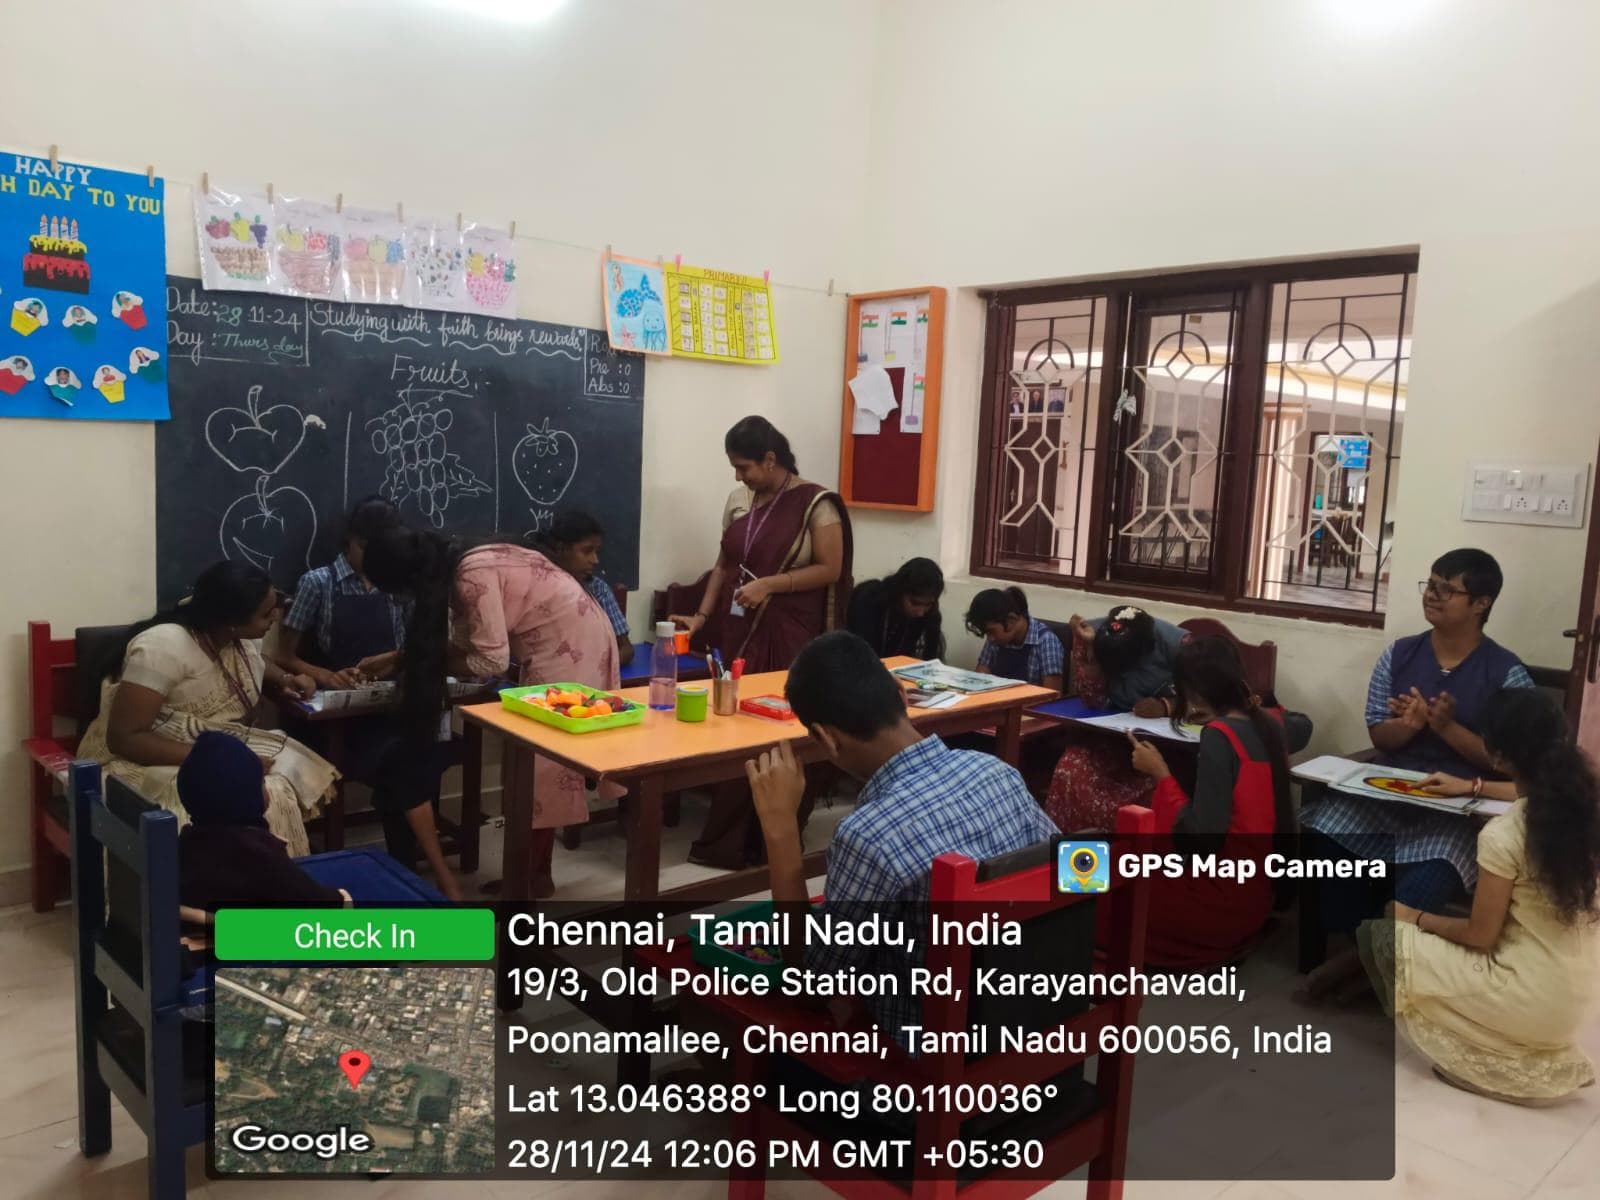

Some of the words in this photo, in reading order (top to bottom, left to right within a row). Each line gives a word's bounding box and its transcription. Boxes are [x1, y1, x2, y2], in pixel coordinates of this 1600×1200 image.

[15, 155, 92, 185] HAPPY
[28, 179, 75, 201] DAY
[87, 187, 115, 207] TO
[125, 194, 160, 215] YOU
[310, 303, 388, 343] Studying
[391, 309, 431, 334] with
[437, 312, 478, 347] faith
[484, 320, 524, 353] brings
[588, 374, 614, 393] Abs
